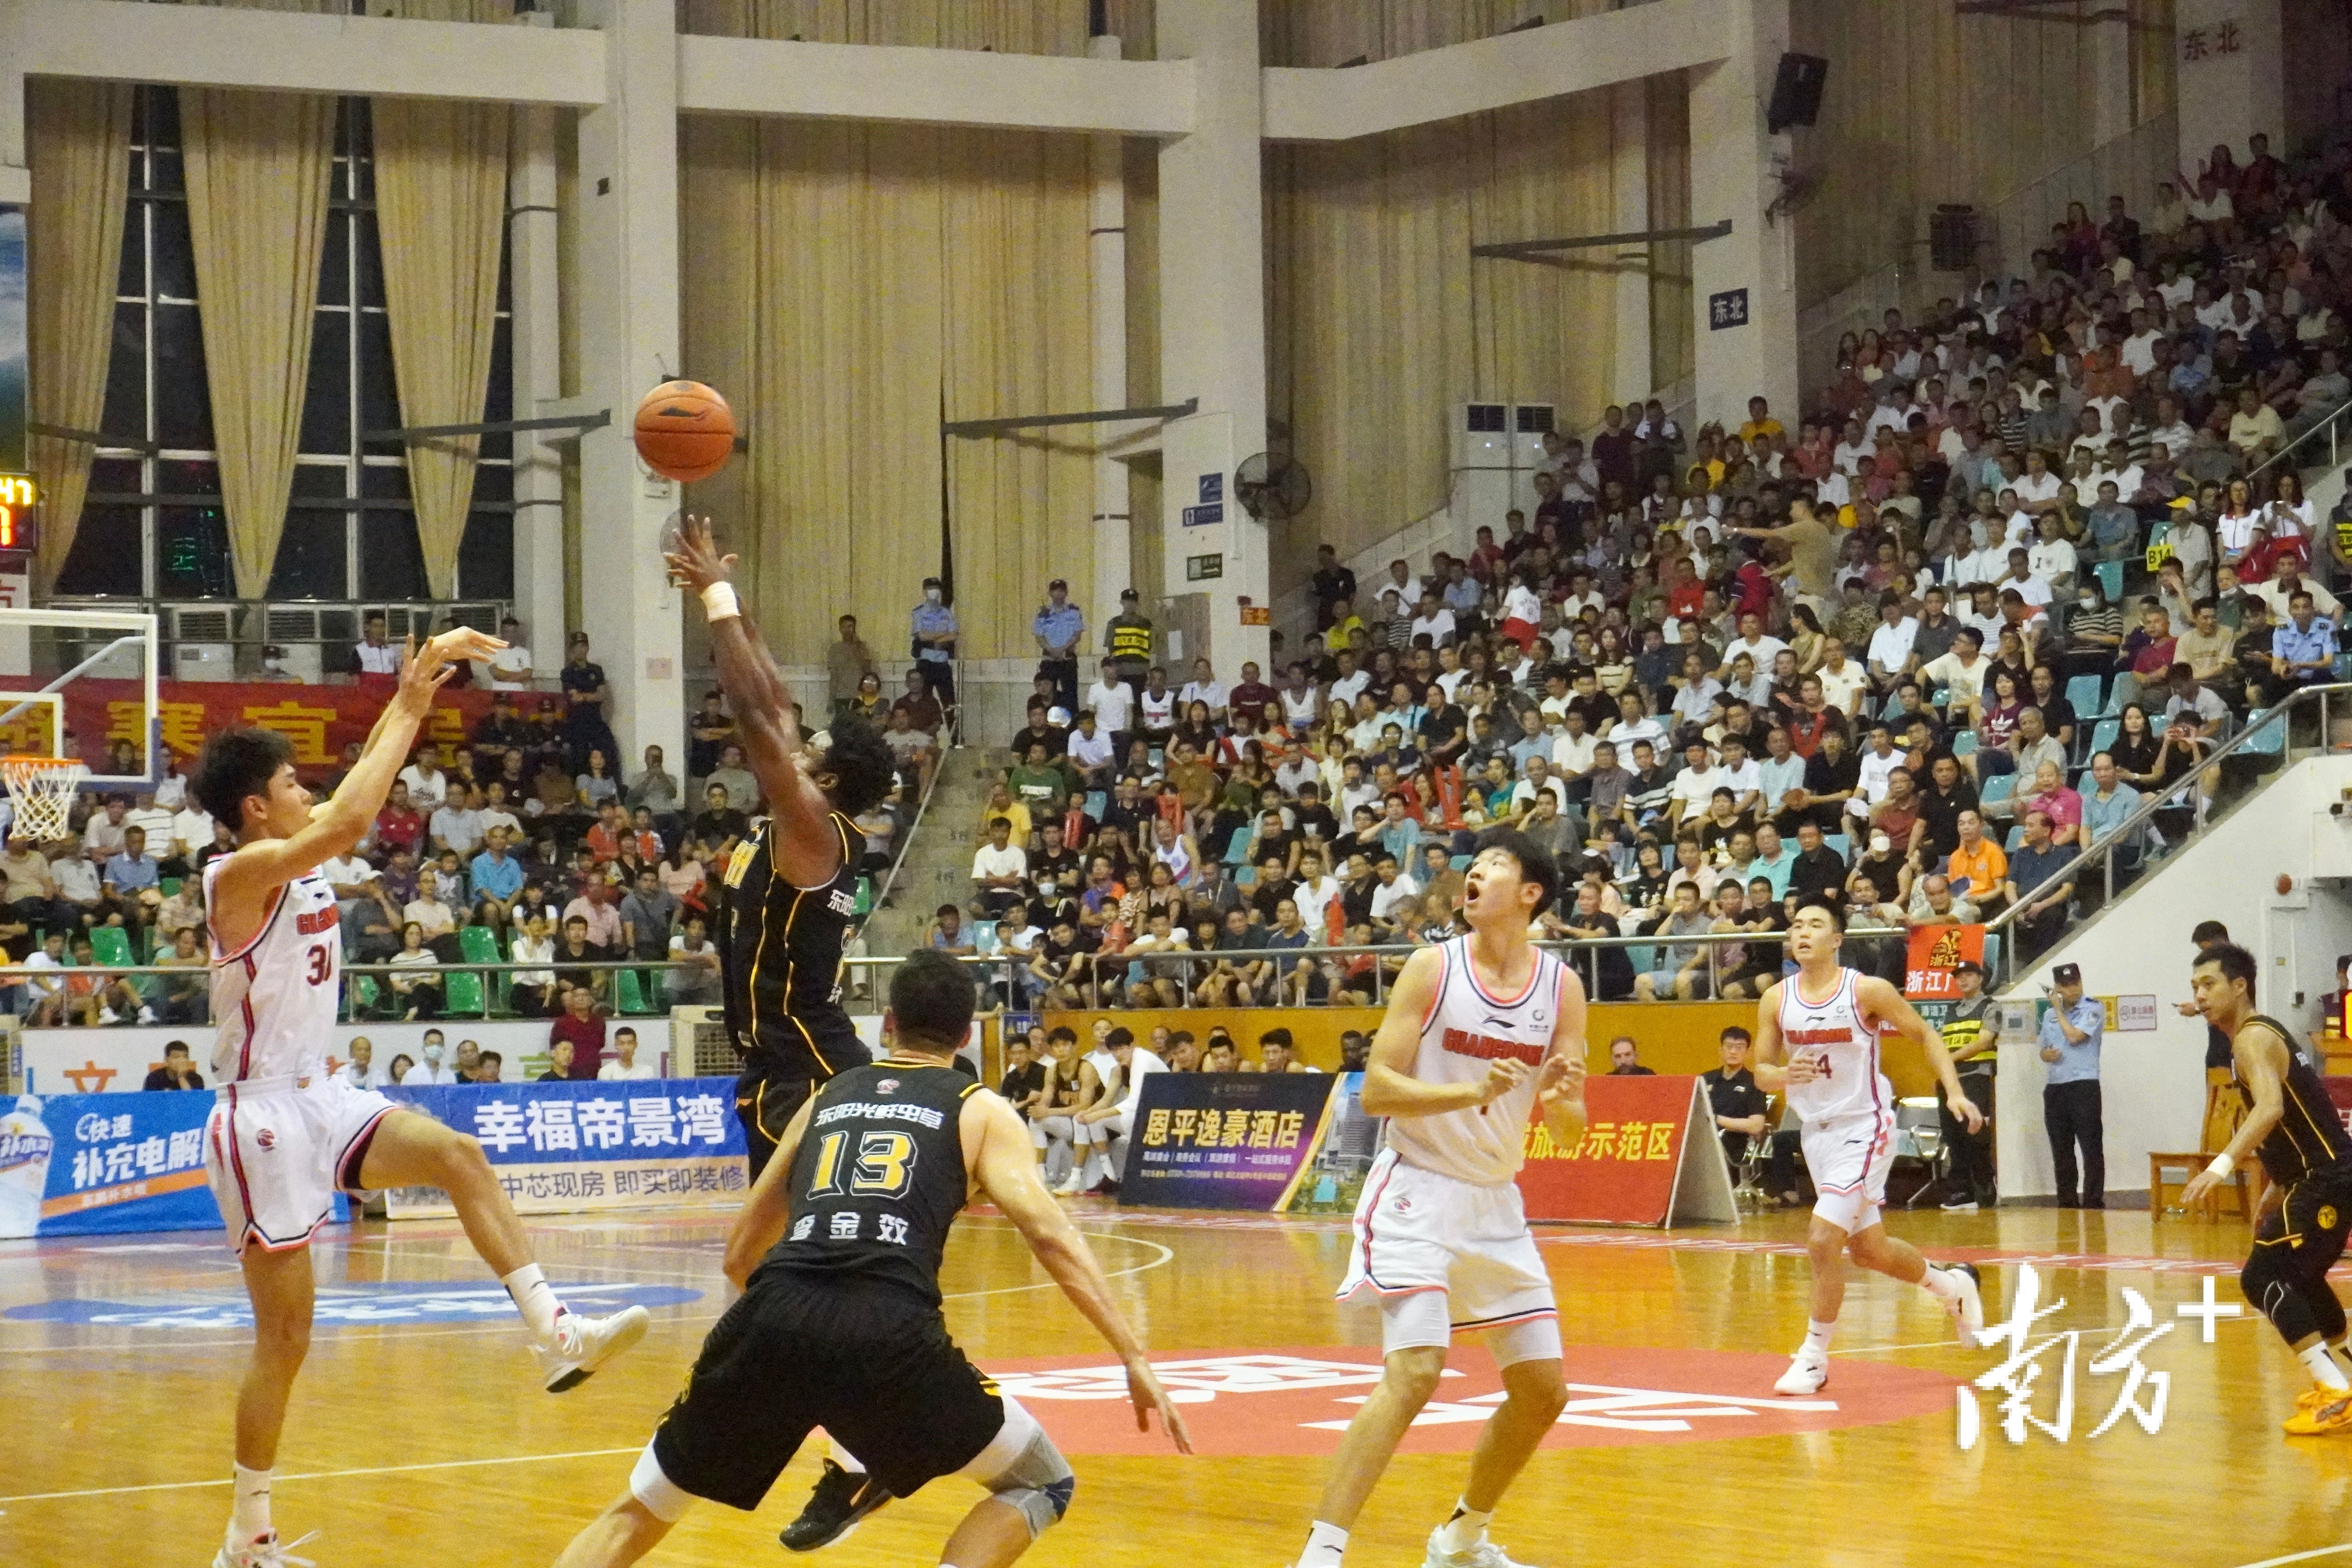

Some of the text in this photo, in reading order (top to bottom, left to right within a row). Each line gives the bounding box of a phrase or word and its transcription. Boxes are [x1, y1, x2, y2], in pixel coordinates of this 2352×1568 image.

[2184, 20, 2240, 60] 东北
[1713, 295, 1744, 324] 东北
[2149, 547, 2171, 564] B14
[307, 941, 332, 986] 31
[1929, 953, 1958, 967] 浙江
[89, 1114, 133, 1143] 快速
[474, 1094, 725, 1153] 幸福帝景湾
[814, 1102, 946, 1130] 东阳光鲜虫草
[1142, 1108, 1305, 1149] 恩平逸豪酒店
[71, 1127, 207, 1189] 补充电解
[806, 1131, 918, 1200] 13
[613, 1166, 746, 1195] 即买即装修
